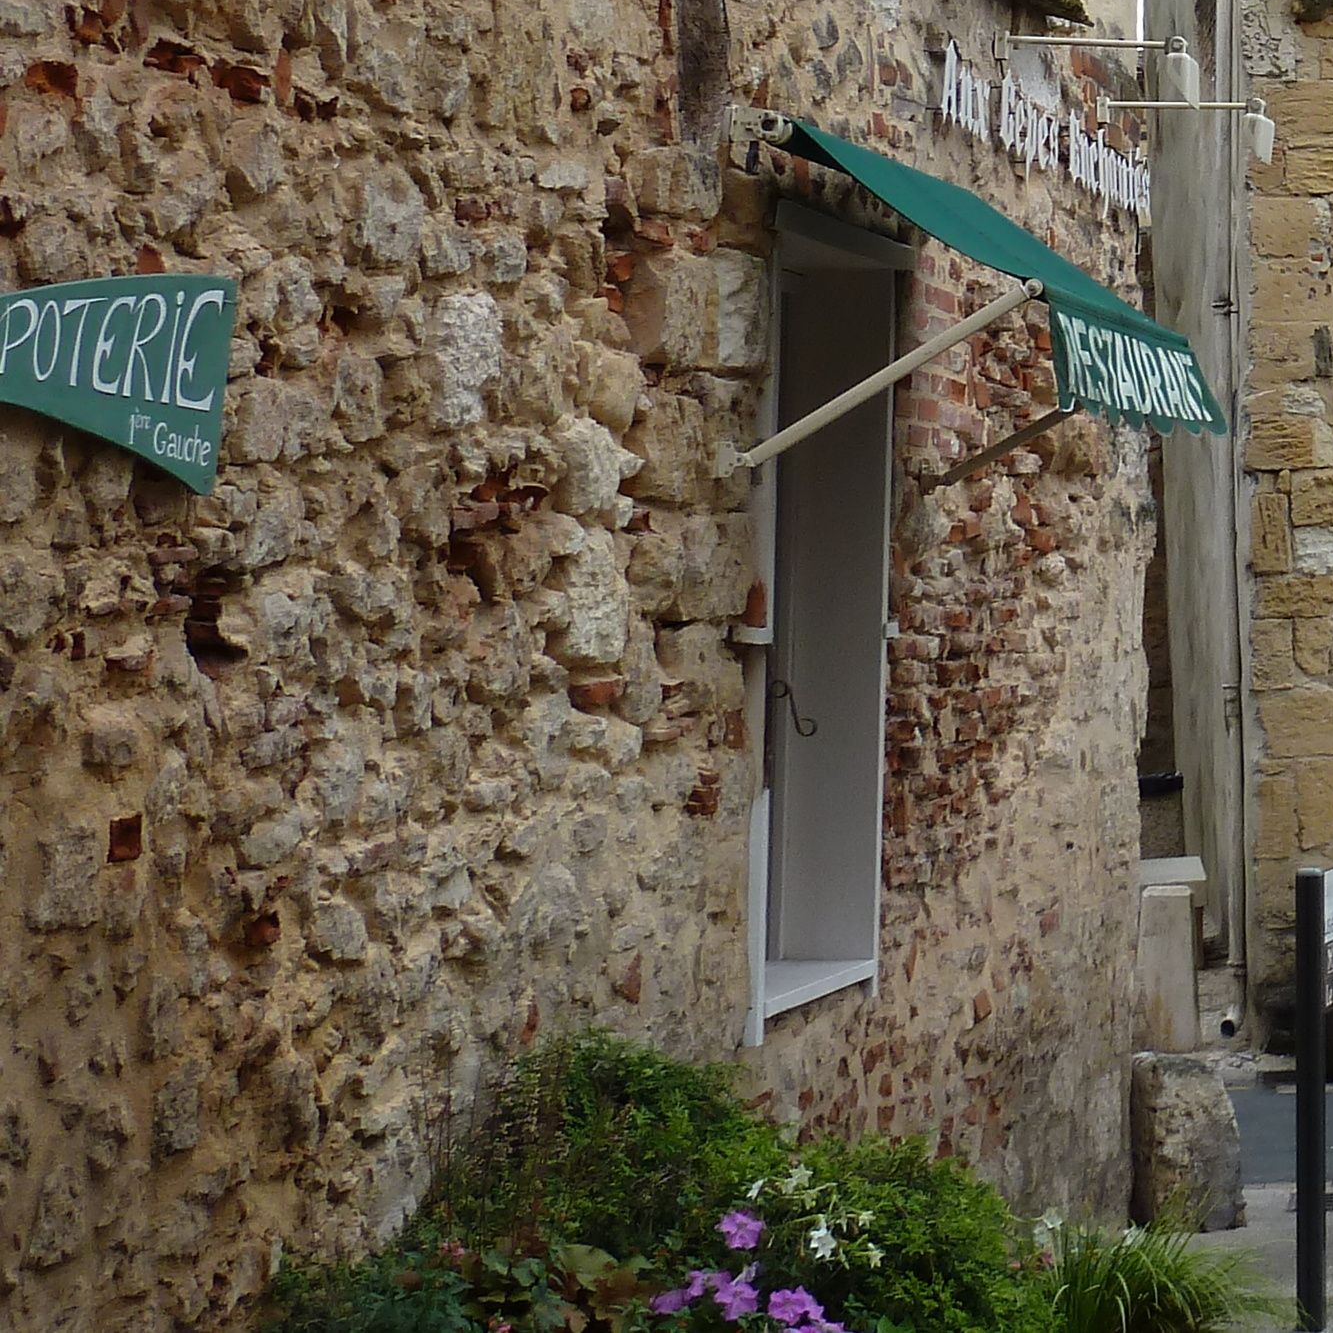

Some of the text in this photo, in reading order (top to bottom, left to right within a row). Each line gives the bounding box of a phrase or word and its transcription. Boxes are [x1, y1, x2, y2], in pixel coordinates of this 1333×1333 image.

[941, 38, 990, 144] Aux
[1057, 311, 1213, 422] RESTAURANT
[153, 421, 212, 467] Gauche
